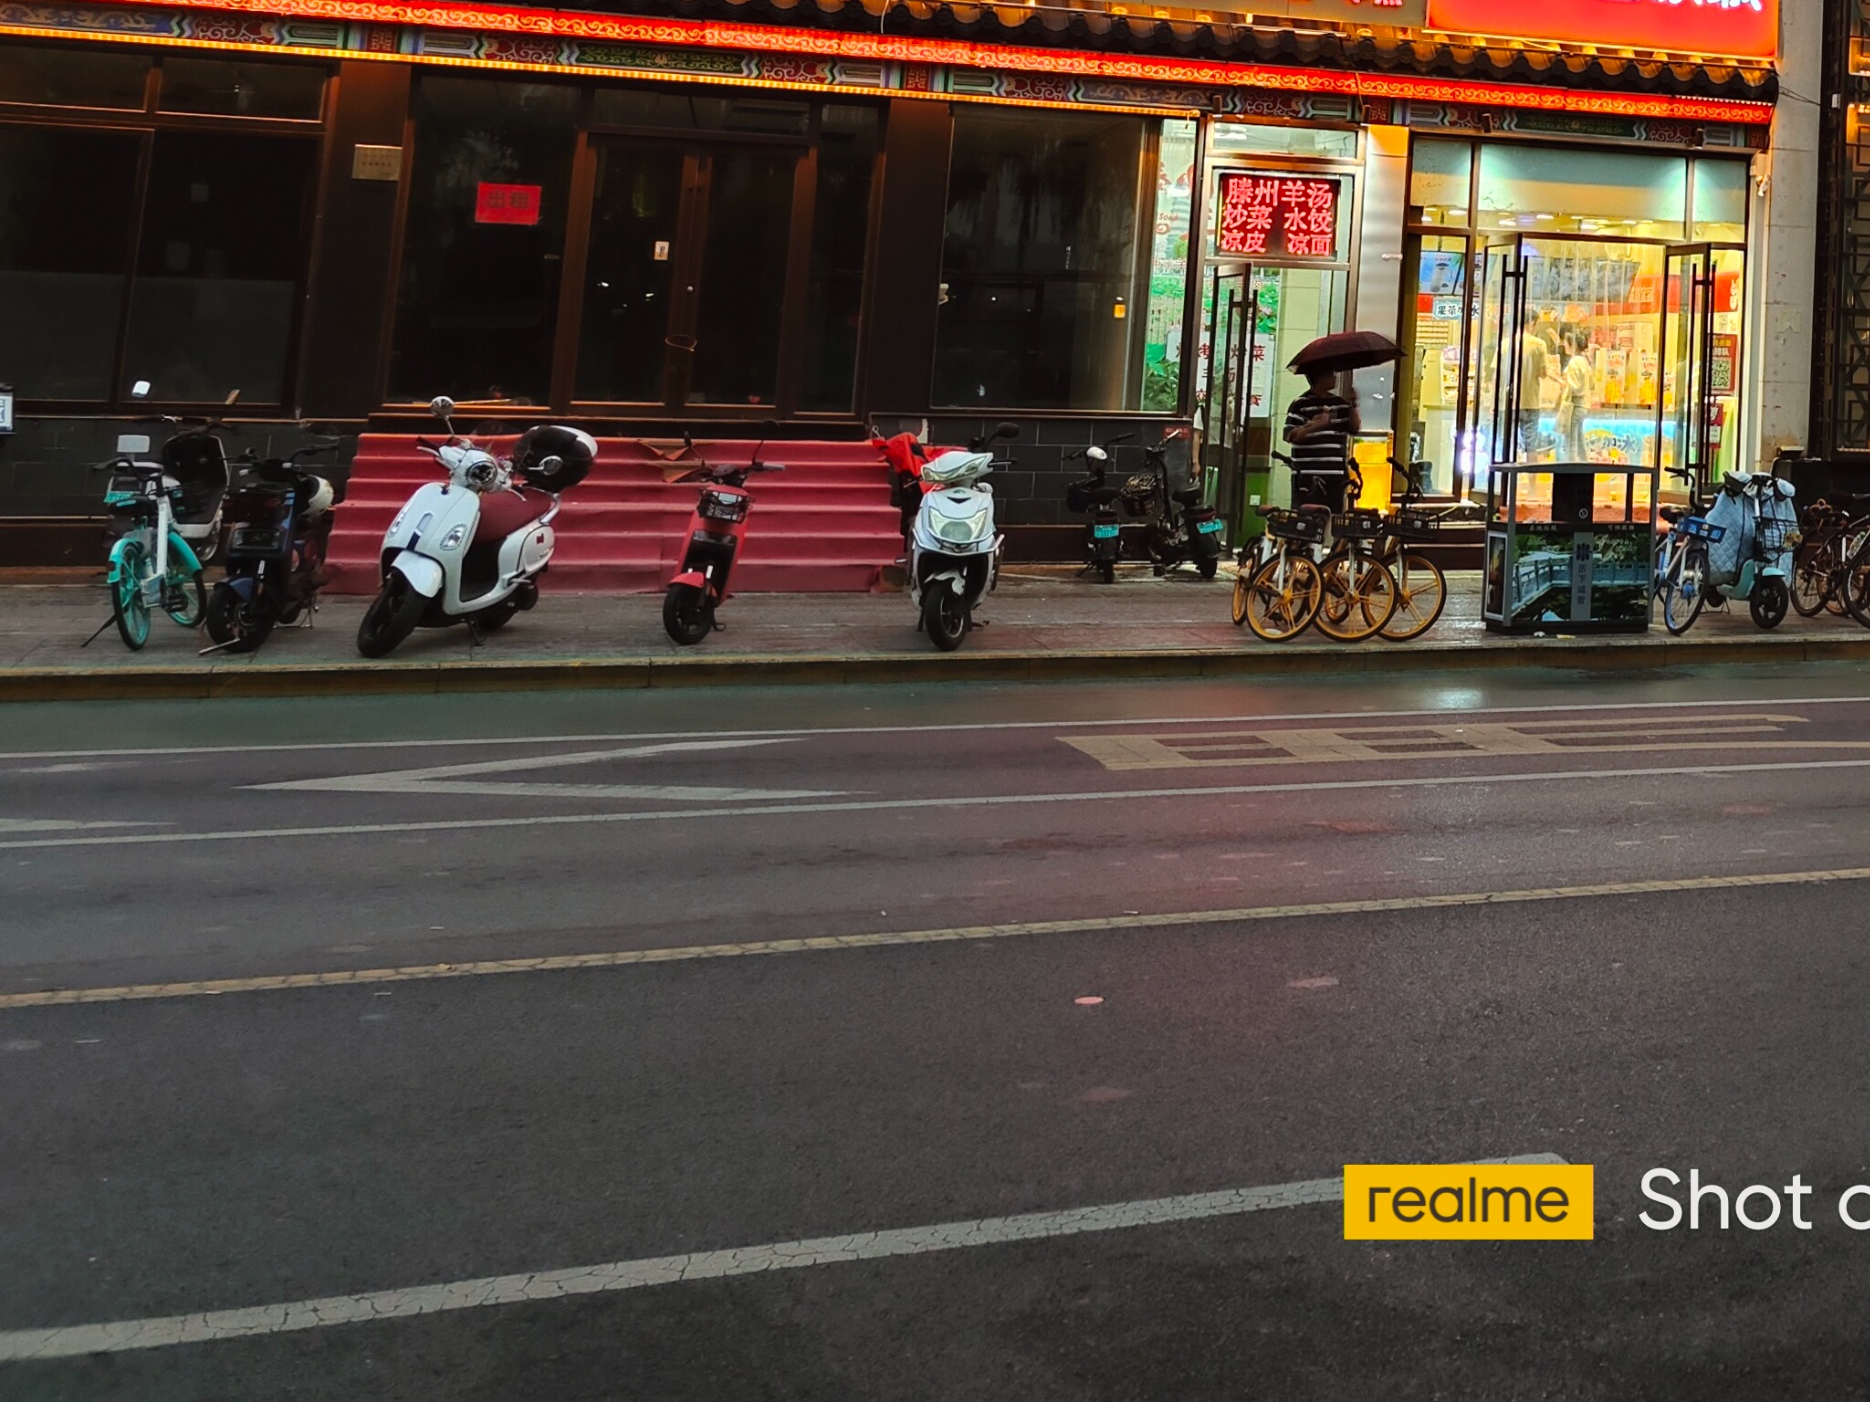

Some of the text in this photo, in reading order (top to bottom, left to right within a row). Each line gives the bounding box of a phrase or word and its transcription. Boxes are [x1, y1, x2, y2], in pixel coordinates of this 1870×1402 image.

[488, 190, 530, 209] 出租
[1225, 176, 1333, 209] 滕州羊汤
[1222, 203, 1333, 233] 炒菜 水饺
[1221, 229, 1267, 253] 凉皮
